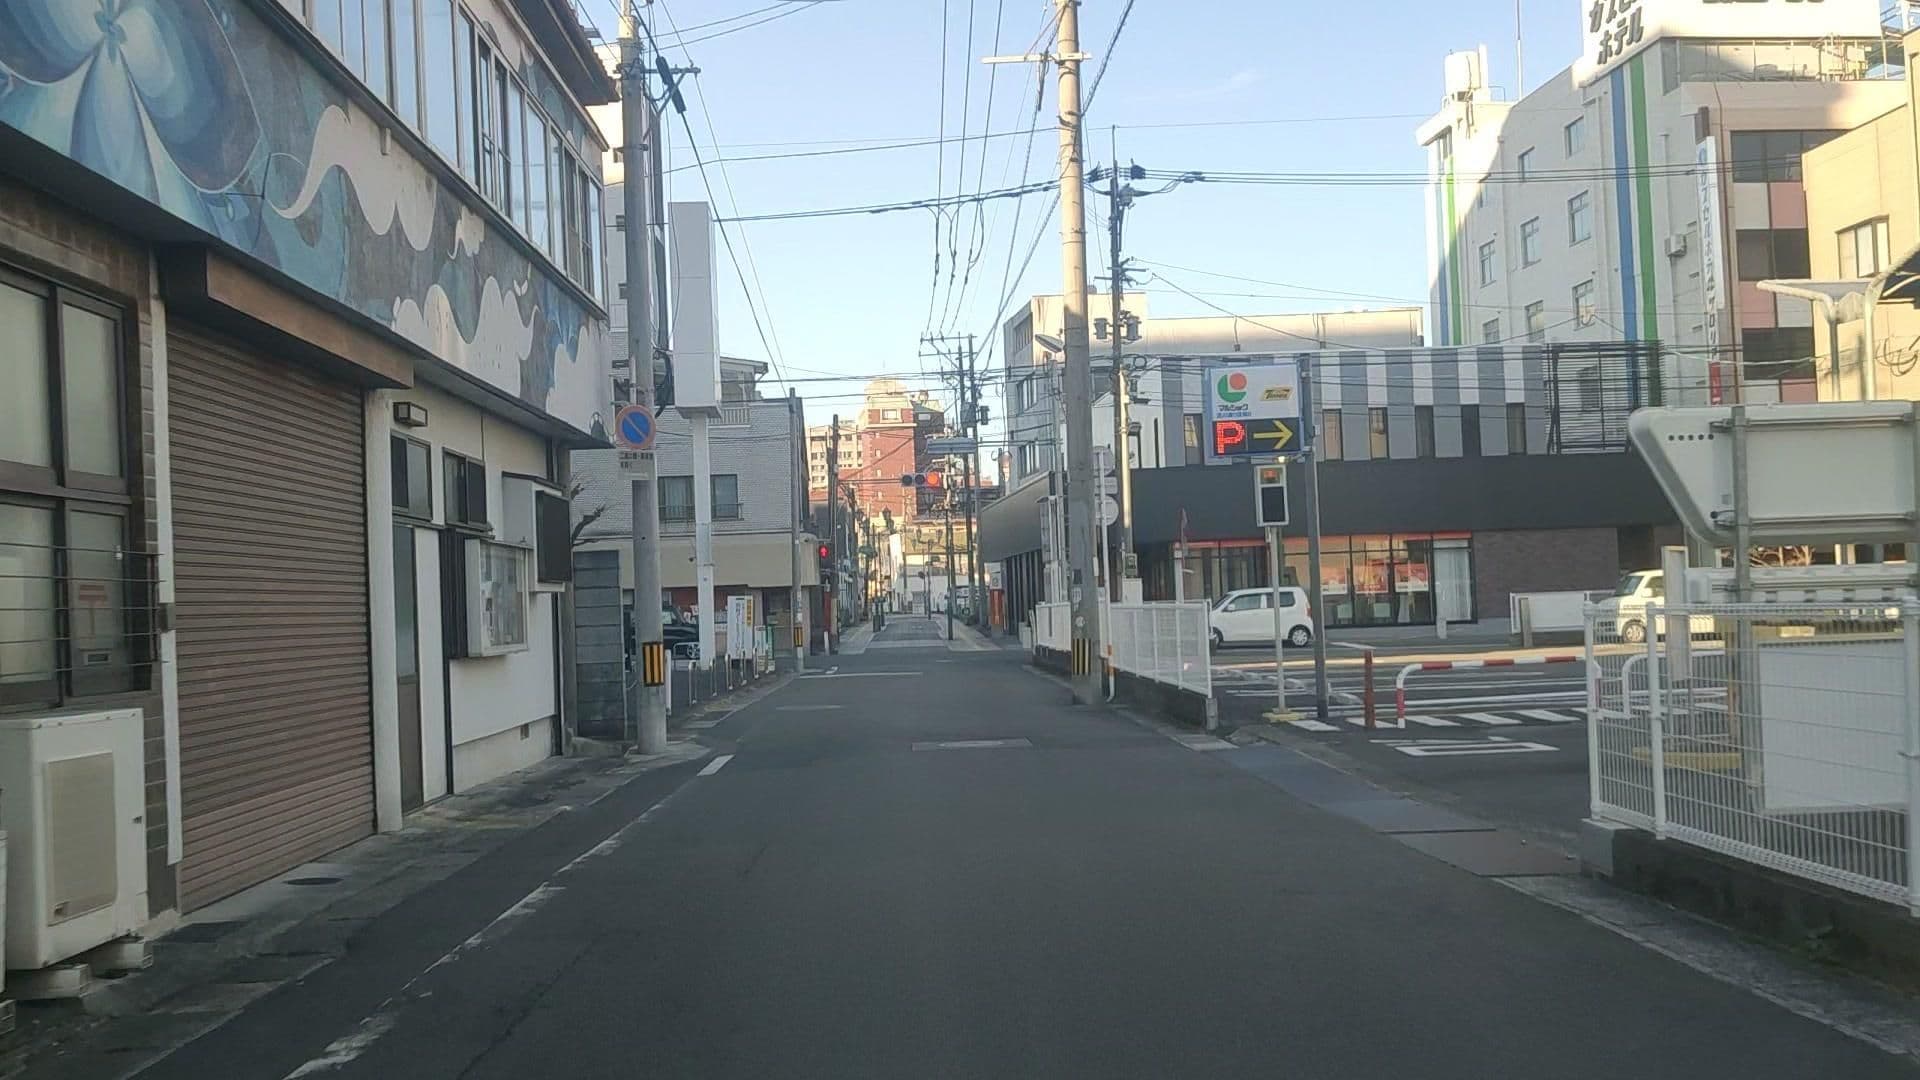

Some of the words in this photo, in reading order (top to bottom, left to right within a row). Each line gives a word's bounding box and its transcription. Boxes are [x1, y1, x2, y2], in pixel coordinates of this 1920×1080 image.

[1597, 6, 1645, 65] ホテル
[1216, 421, 1245, 454] P
